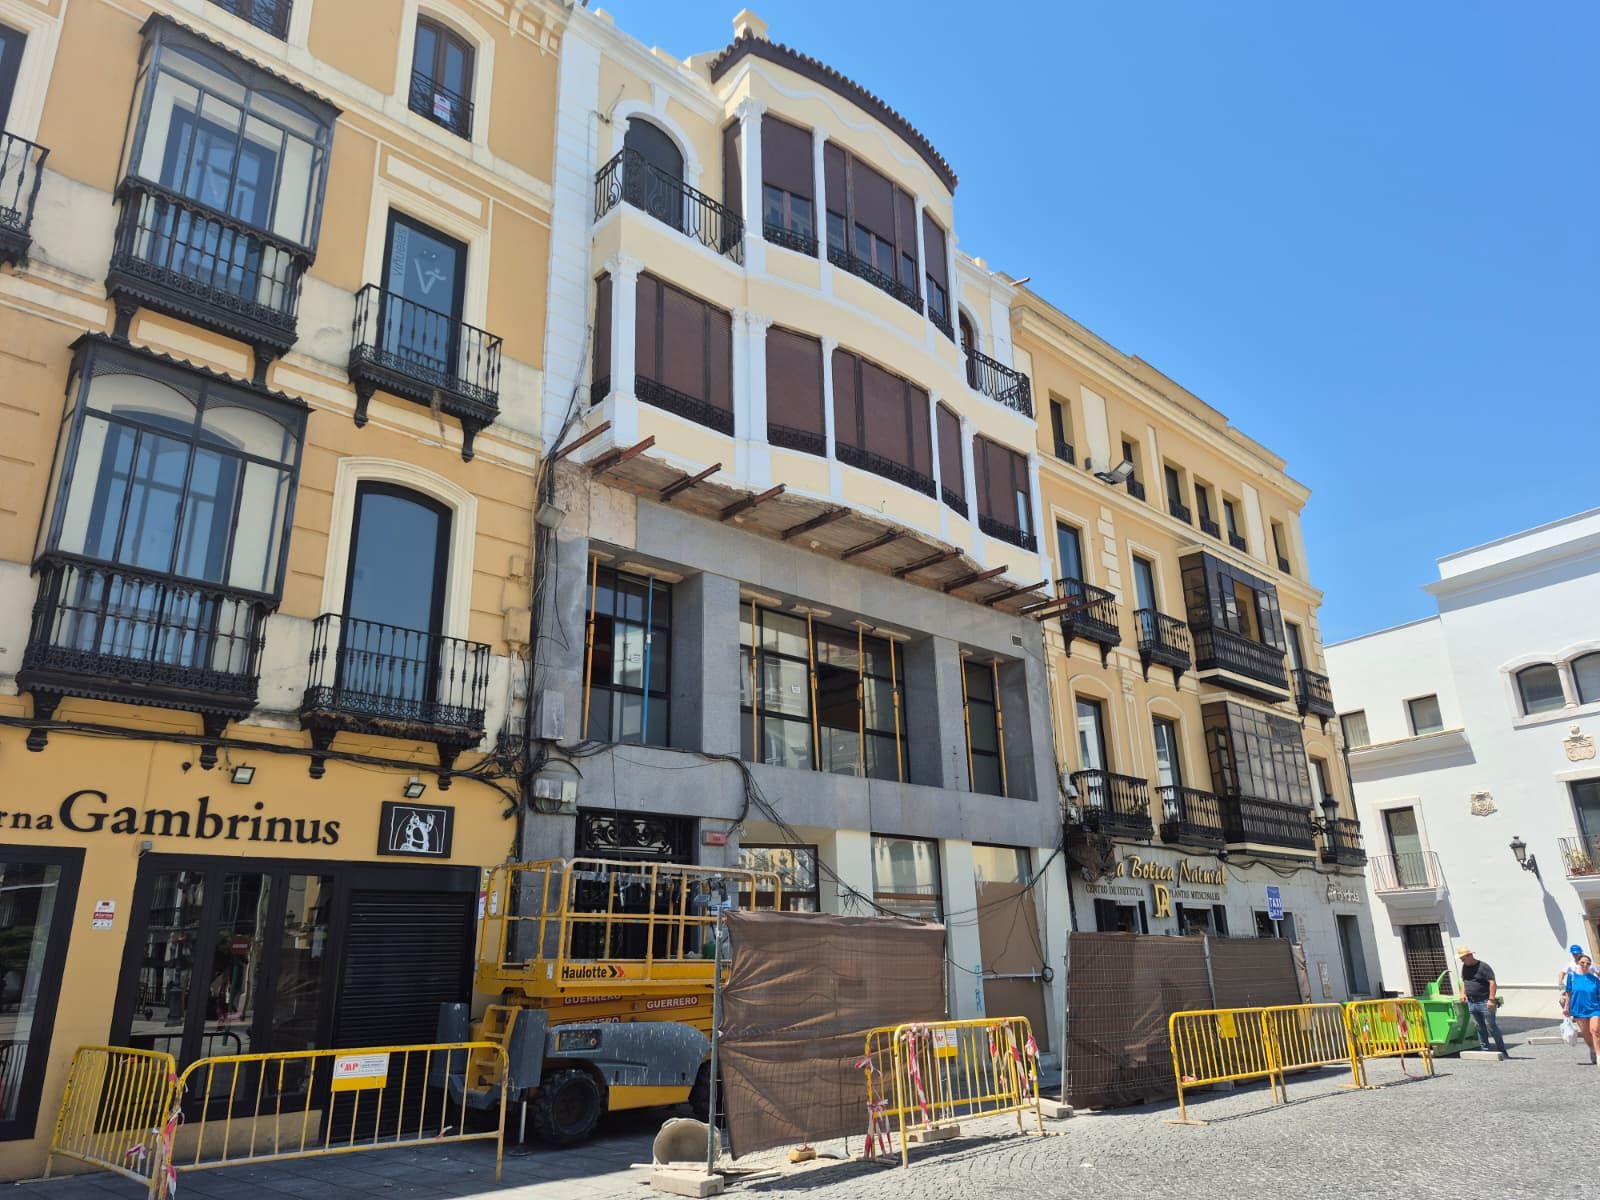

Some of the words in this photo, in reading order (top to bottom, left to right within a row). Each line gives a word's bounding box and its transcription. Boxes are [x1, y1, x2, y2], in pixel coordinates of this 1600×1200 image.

[59, 789, 341, 845] Gambrinus
[1128, 855, 1174, 881] Botica
[1177, 858, 1227, 888] Natural
[561, 965, 607, 979] Haulotte
[646, 997, 698, 1009] GUERRERO
